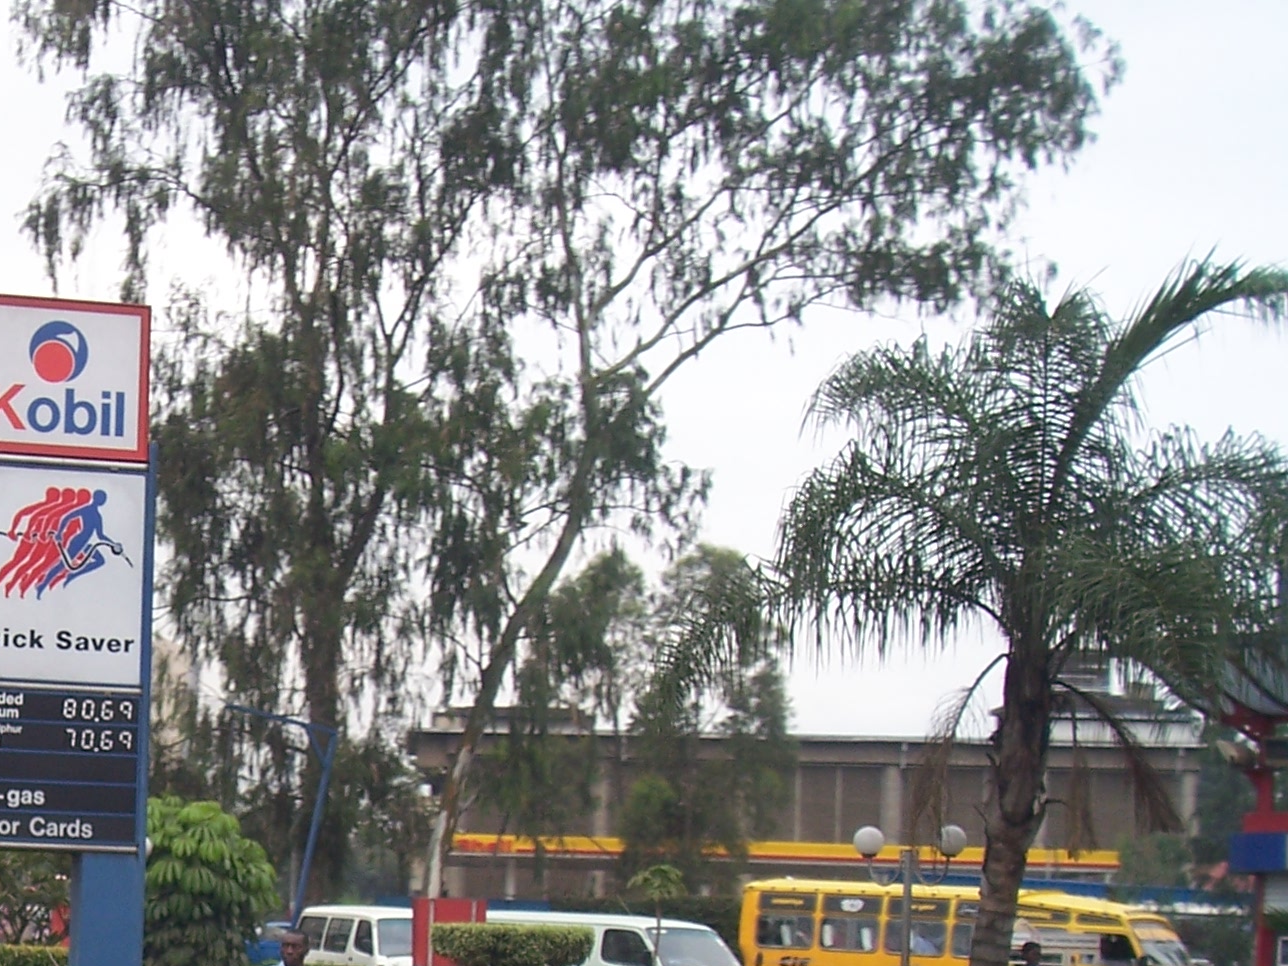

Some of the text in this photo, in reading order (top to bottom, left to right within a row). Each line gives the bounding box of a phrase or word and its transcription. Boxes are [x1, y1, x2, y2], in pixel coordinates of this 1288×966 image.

[56, 630, 135, 653] Saver
[63, 698, 133, 723] 80.69
[65, 728, 133, 752] 70.69
[29, 817, 94, 839] Cards
